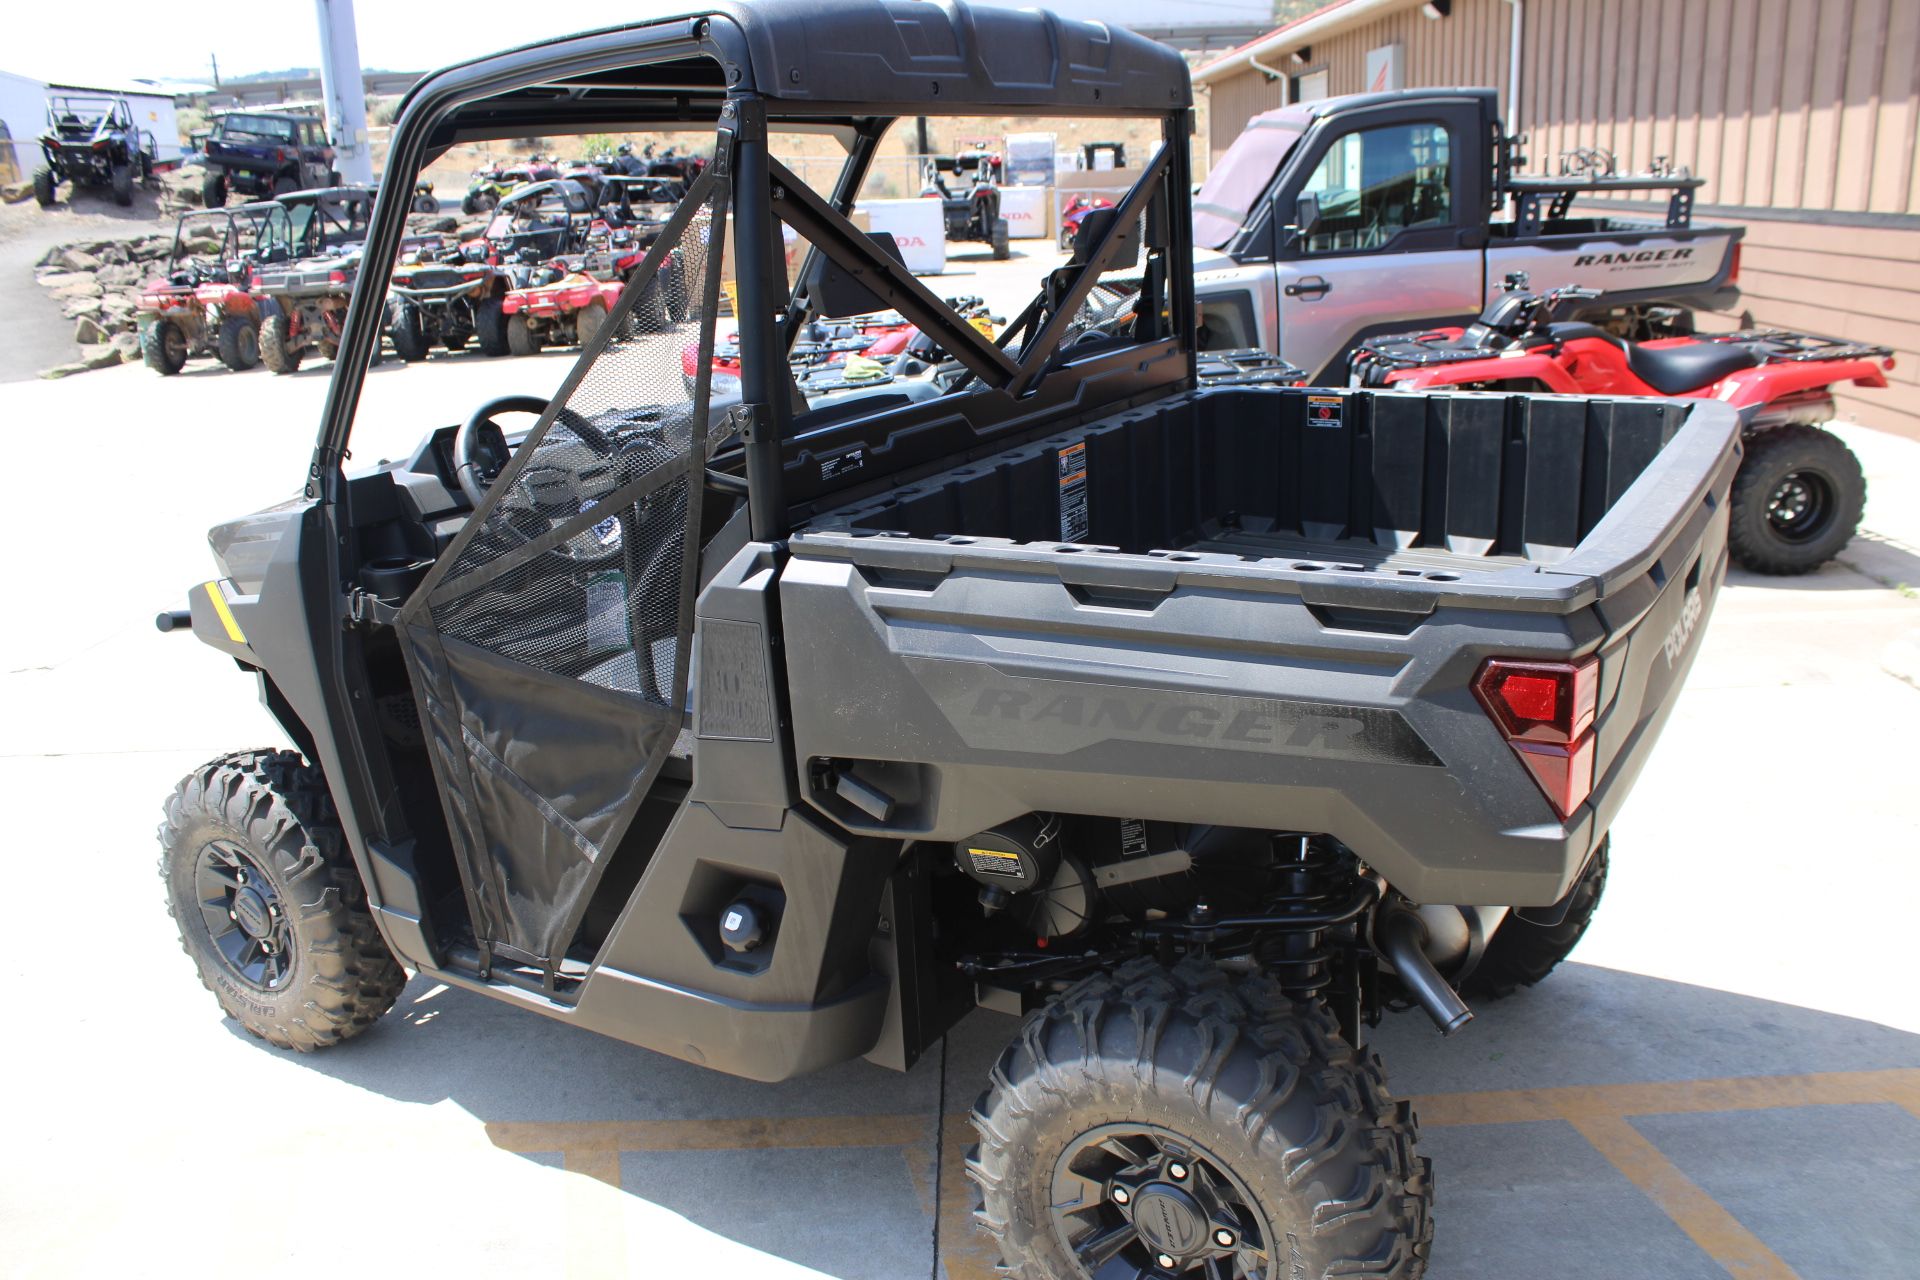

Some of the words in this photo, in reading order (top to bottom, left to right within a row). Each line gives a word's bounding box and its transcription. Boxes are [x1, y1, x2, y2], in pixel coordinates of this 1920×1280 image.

[1001, 212, 1033, 221] NDA
[1574, 248, 1694, 266] RANGER
[1665, 587, 1702, 670] POLARIS
[969, 688, 1365, 751] RANGER
